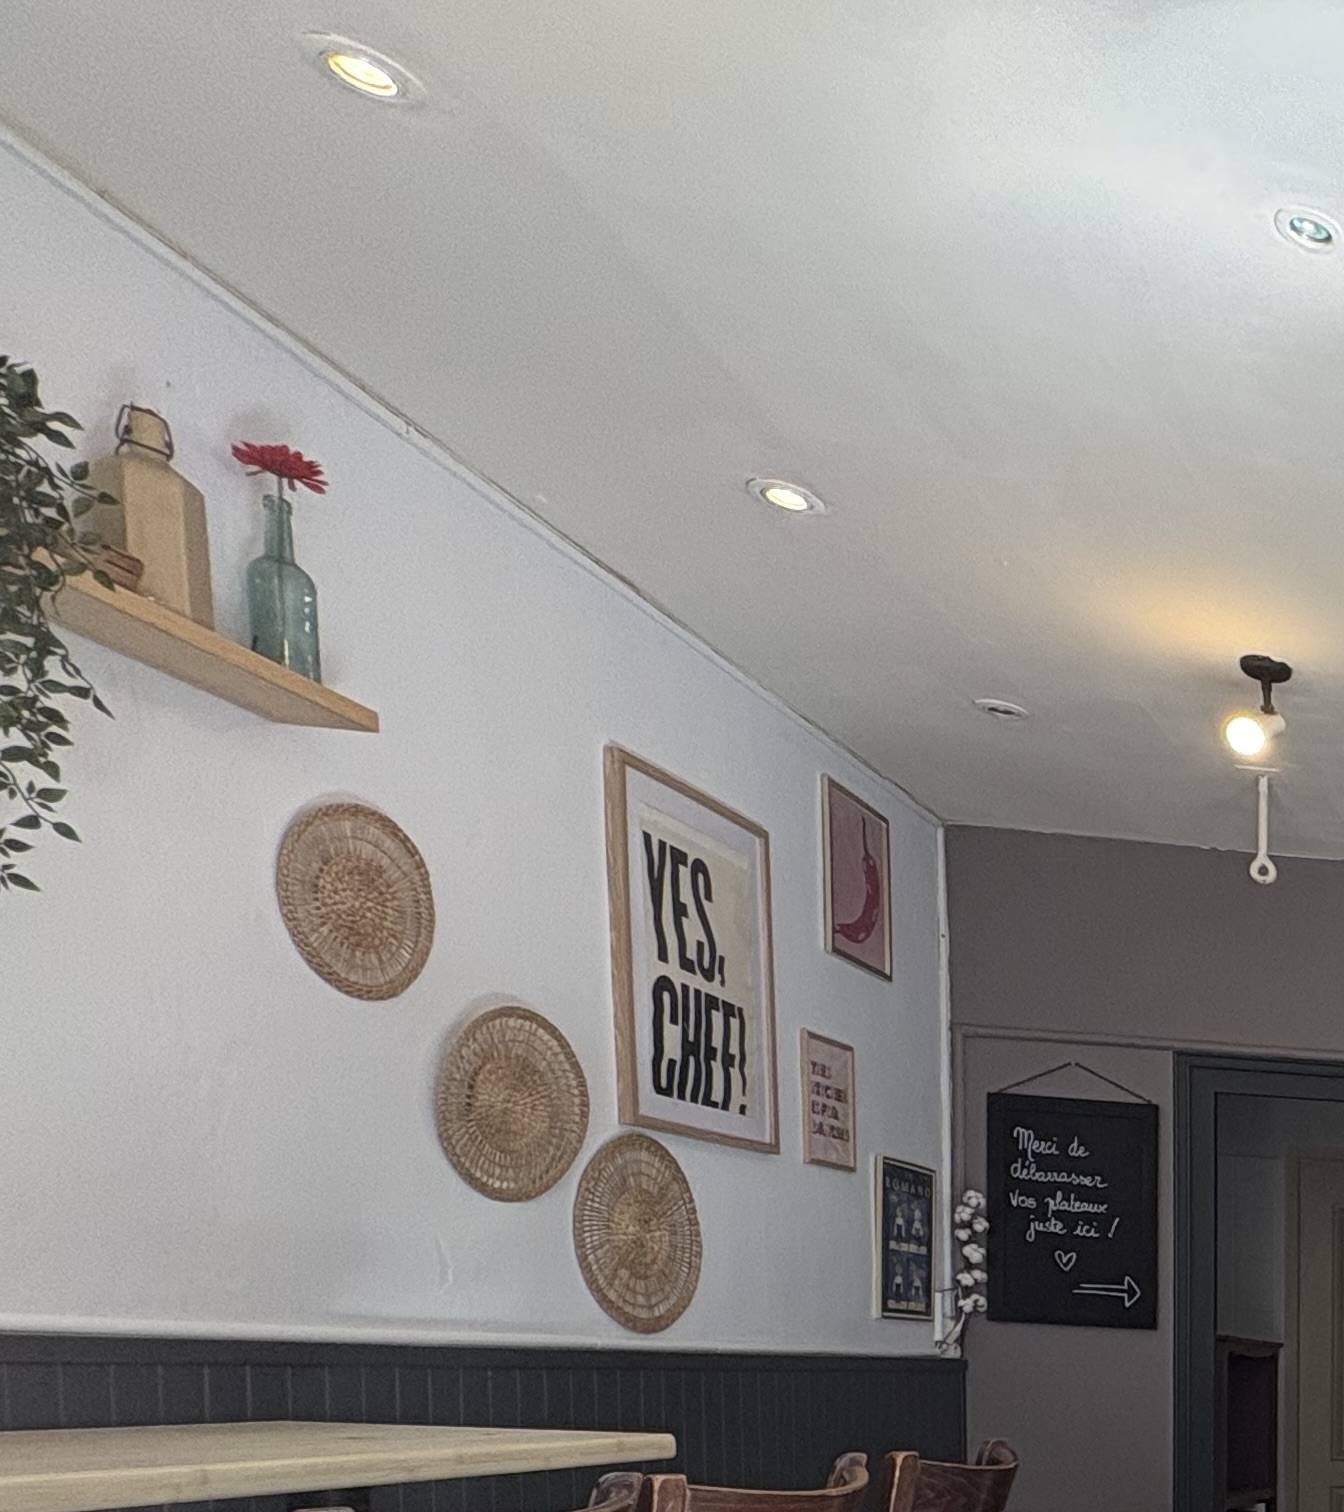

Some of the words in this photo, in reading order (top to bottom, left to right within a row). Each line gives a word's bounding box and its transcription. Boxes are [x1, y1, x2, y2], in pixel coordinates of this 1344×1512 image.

[642, 829, 727, 988] YES,
[651, 974, 749, 1116] CHEF!
[1013, 1126, 1059, 1161] Merci
[1068, 1136, 1090, 1158] de
[1010, 1159, 1108, 1188] débarrasser
[1043, 1190, 1108, 1217] plateaux
[1025, 1215, 1067, 1242] juste
[1072, 1222, 1100, 1238] ici
